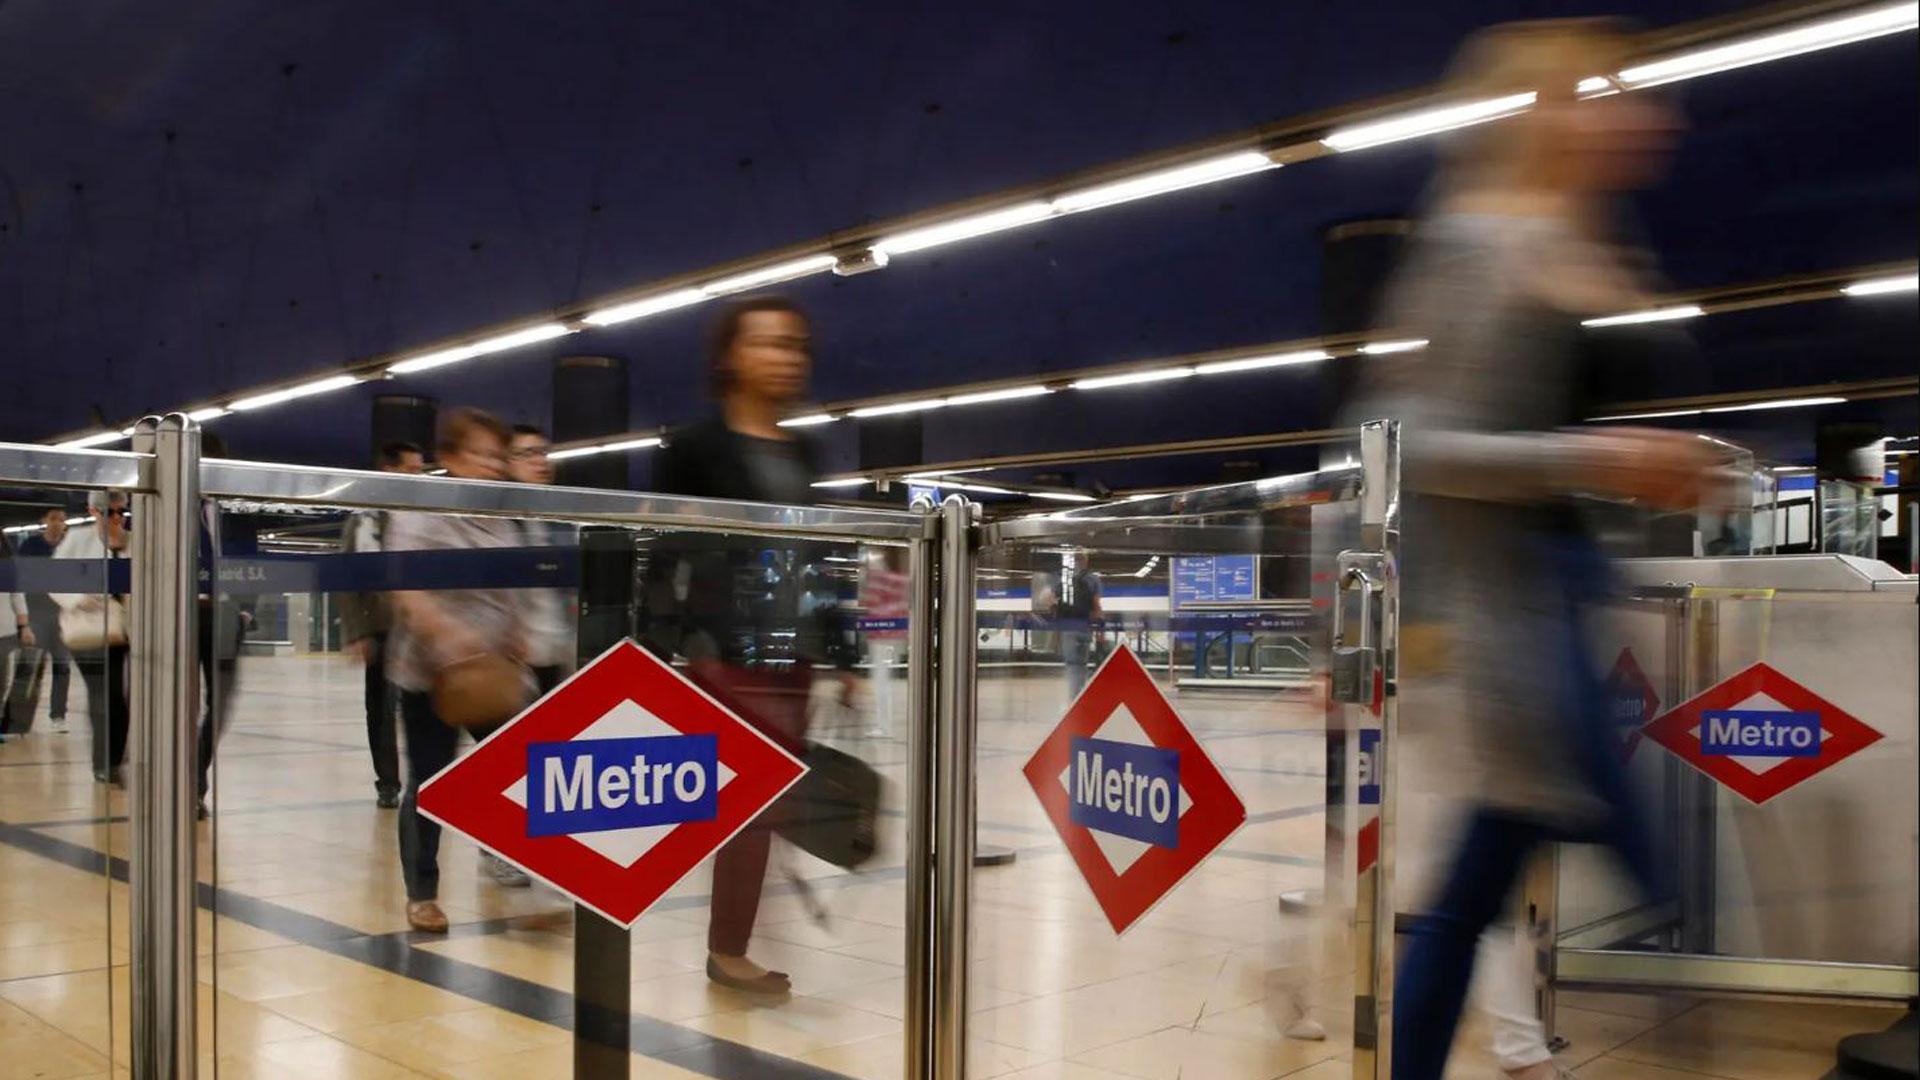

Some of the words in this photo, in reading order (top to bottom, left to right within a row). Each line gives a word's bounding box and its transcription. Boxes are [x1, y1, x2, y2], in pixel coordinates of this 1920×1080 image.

[1708, 718, 1812, 748] Metro
[543, 754, 706, 813] Metro
[1077, 750, 1171, 824] Metro
